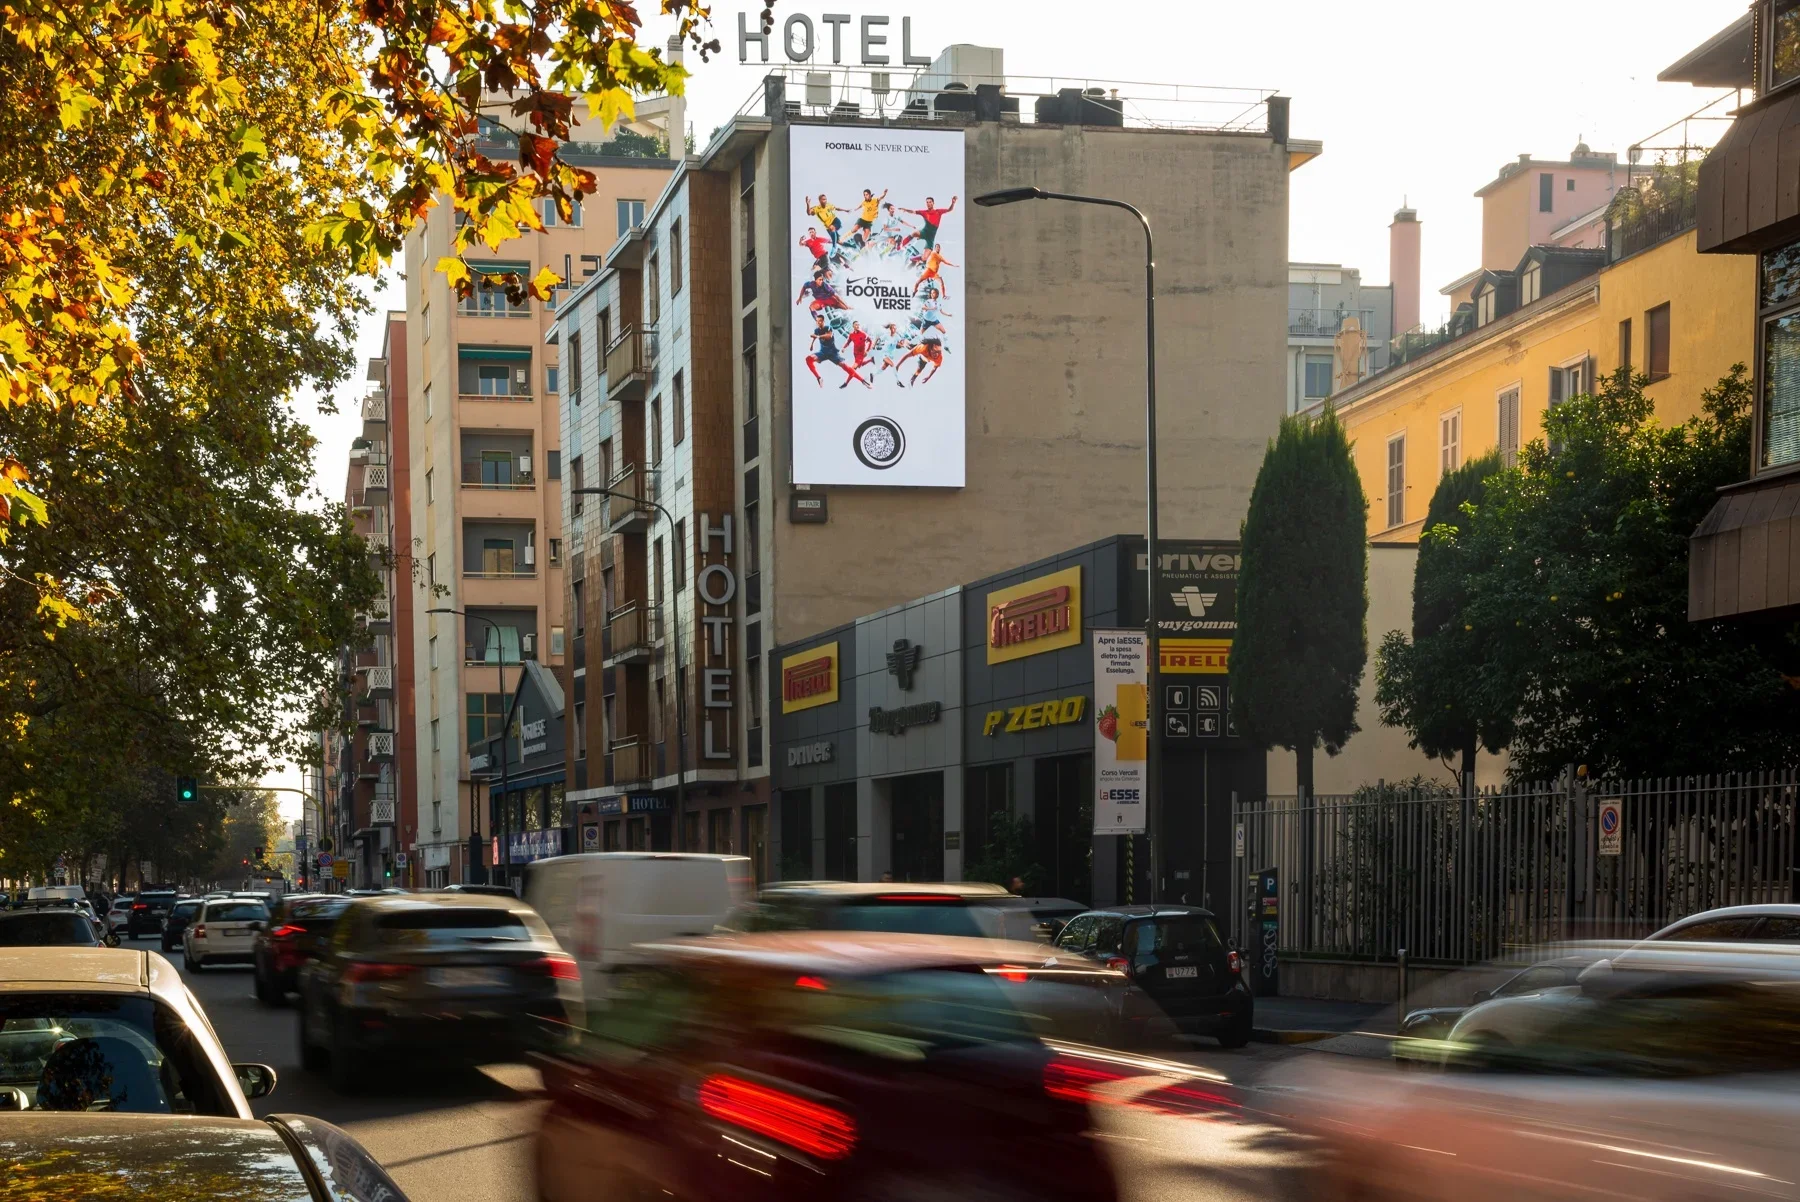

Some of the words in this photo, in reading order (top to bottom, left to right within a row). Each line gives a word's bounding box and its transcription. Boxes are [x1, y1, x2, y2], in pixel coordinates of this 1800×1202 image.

[738, 12, 931, 65] HOTEL
[825, 142, 862, 151] FOOTBALL
[864, 143, 872, 151] IS
[874, 144, 902, 152] NEVER
[867, 276, 878, 285] FC
[846, 285, 911, 298] FOOTBALL
[873, 298, 911, 310] VERSE
[991, 586, 1070, 648] PIRELLI
[698, 513, 735, 758] HOTEL
[1098, 637, 1115, 645] Apre
[784, 656, 831, 701] PIRELLI
[983, 711, 1004, 736] P
[1005, 696, 1086, 732] ZERO
[632, 797, 670, 810] HOTEL
[1266, 878, 1274, 890] P
